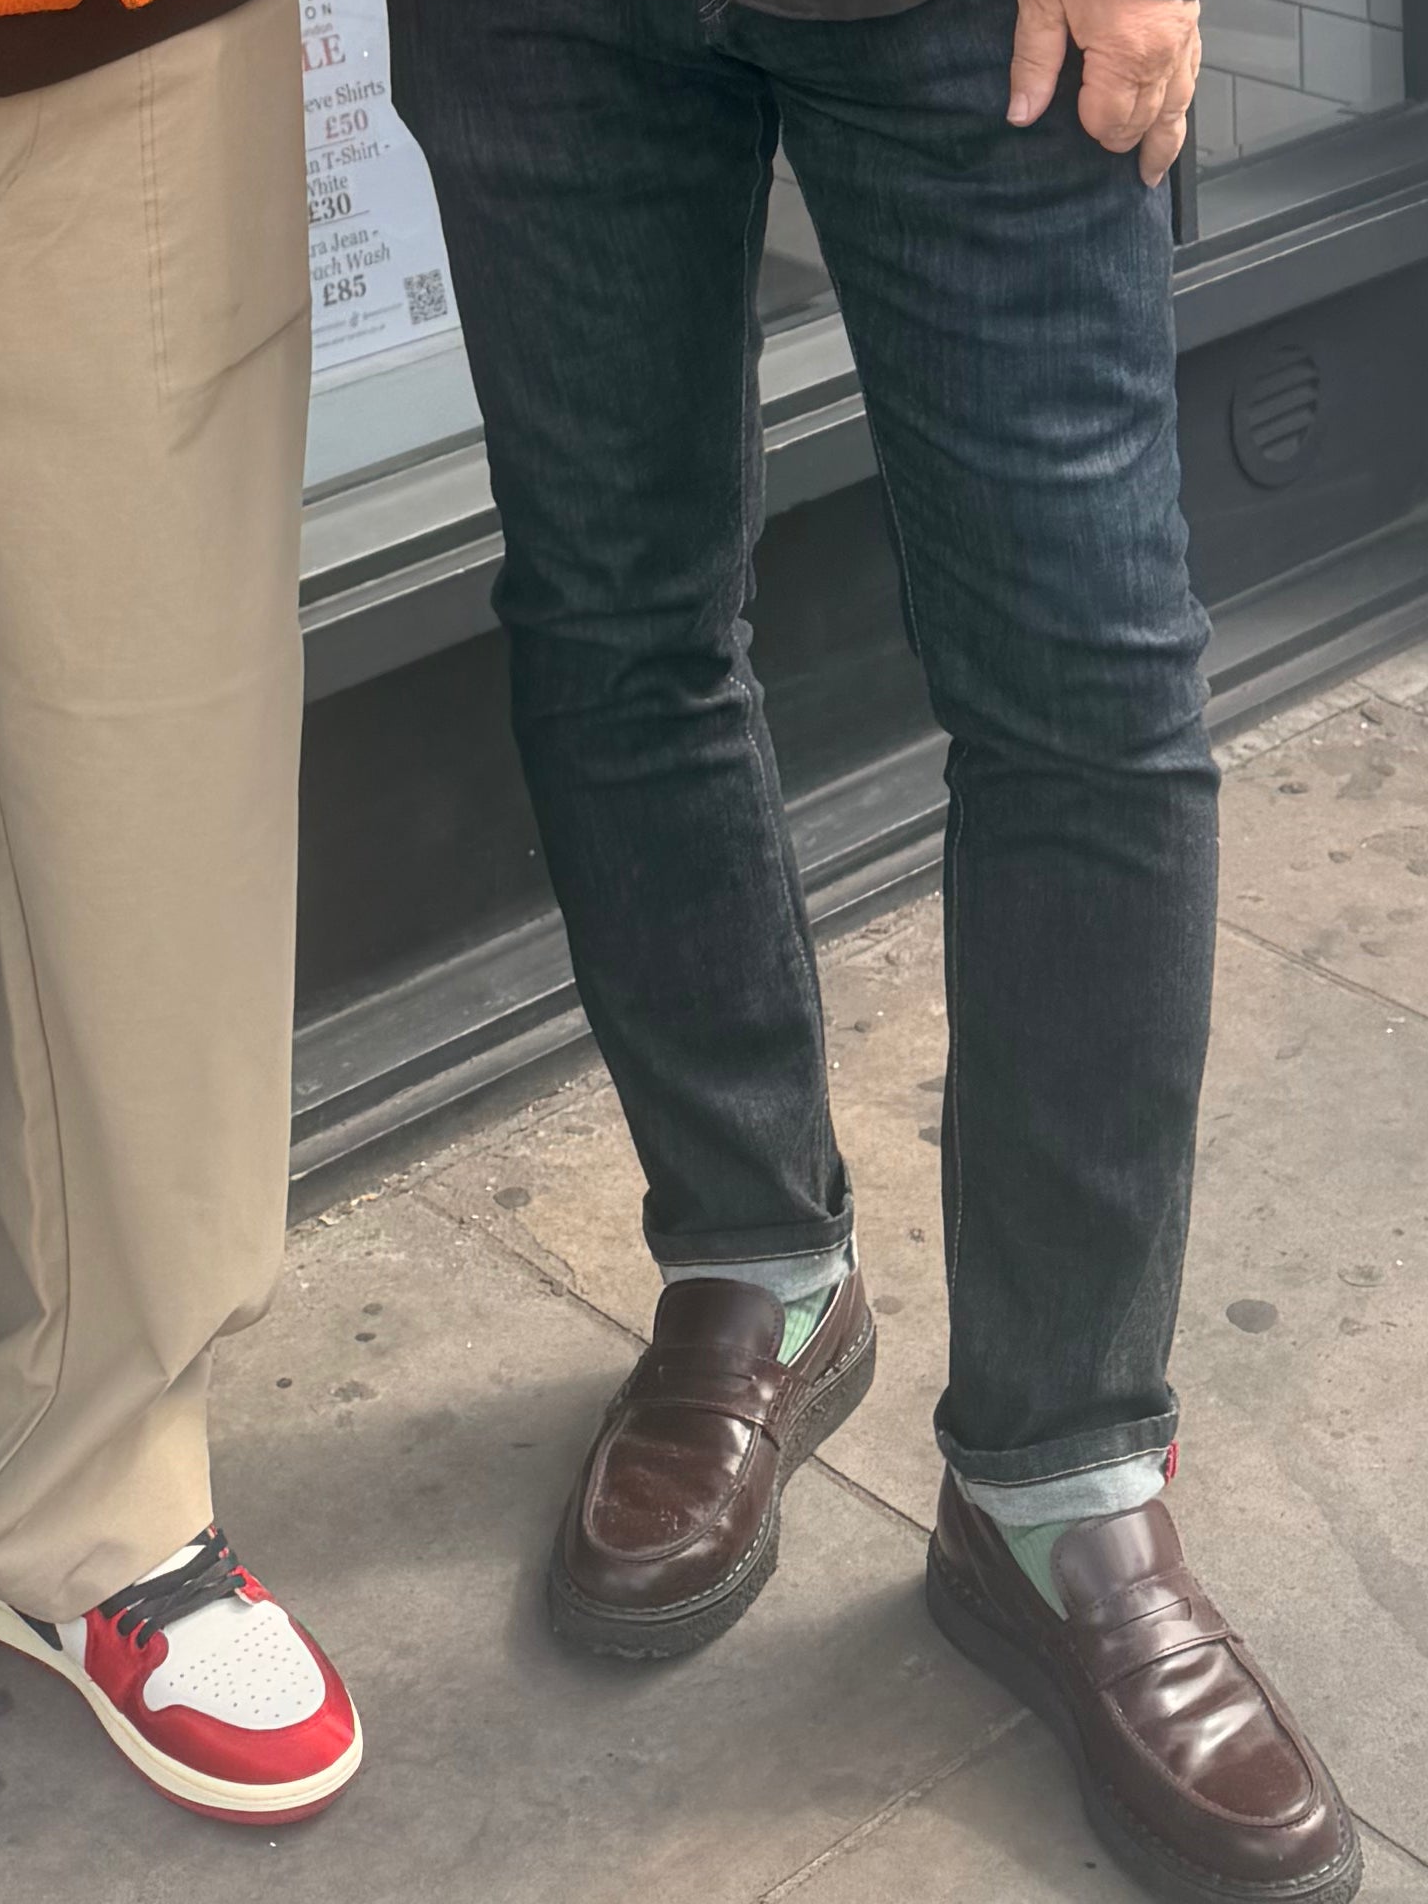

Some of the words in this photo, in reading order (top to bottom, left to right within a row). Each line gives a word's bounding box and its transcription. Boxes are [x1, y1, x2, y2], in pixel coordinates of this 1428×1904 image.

[335, 80, 386, 106] Shirts
[325, 109, 369, 140] £50
[322, 142, 381, 171] T-Shirt
[308, 193, 352, 223] £30
[329, 228, 369, 252] Jean
[346, 243, 391, 271] Wash
[322, 274, 367, 307] £85
